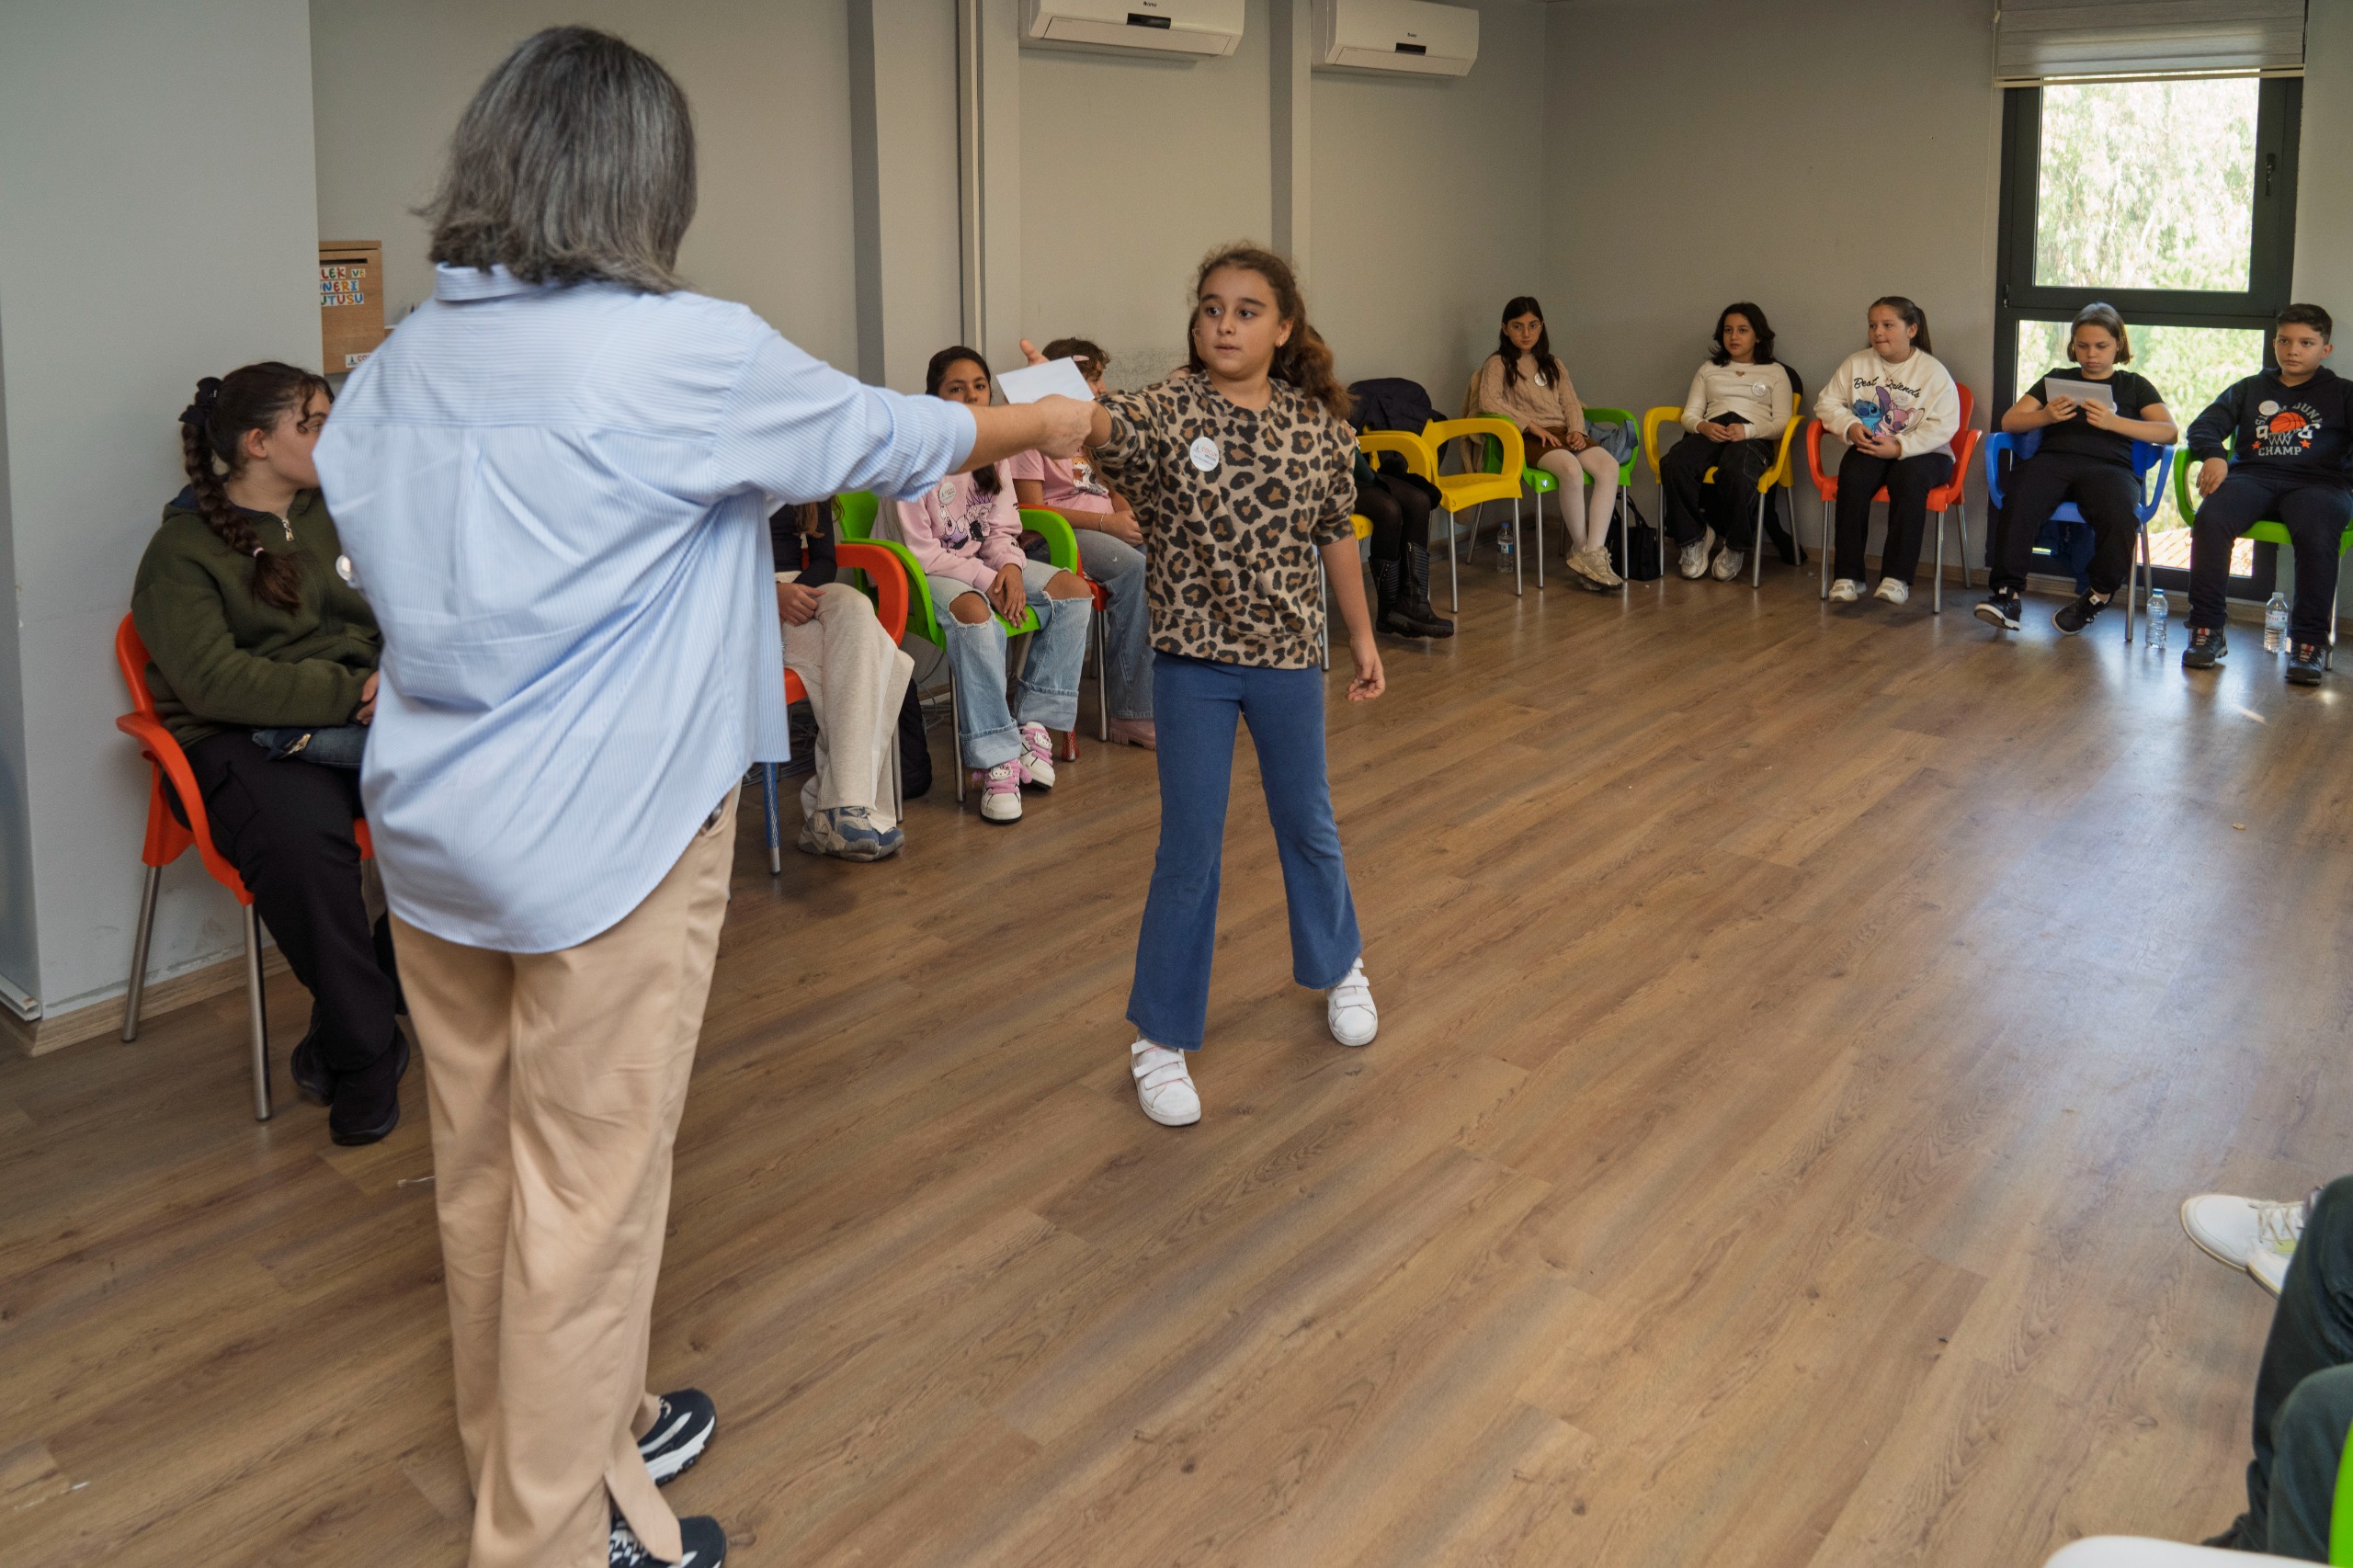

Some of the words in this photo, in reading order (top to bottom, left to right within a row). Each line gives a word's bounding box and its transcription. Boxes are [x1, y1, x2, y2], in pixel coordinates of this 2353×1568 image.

[320, 280, 358, 292] NERI
[1853, 376, 1879, 389] Best
[2255, 405, 2289, 426] SLM
[2258, 446, 2302, 457] CHAMP
